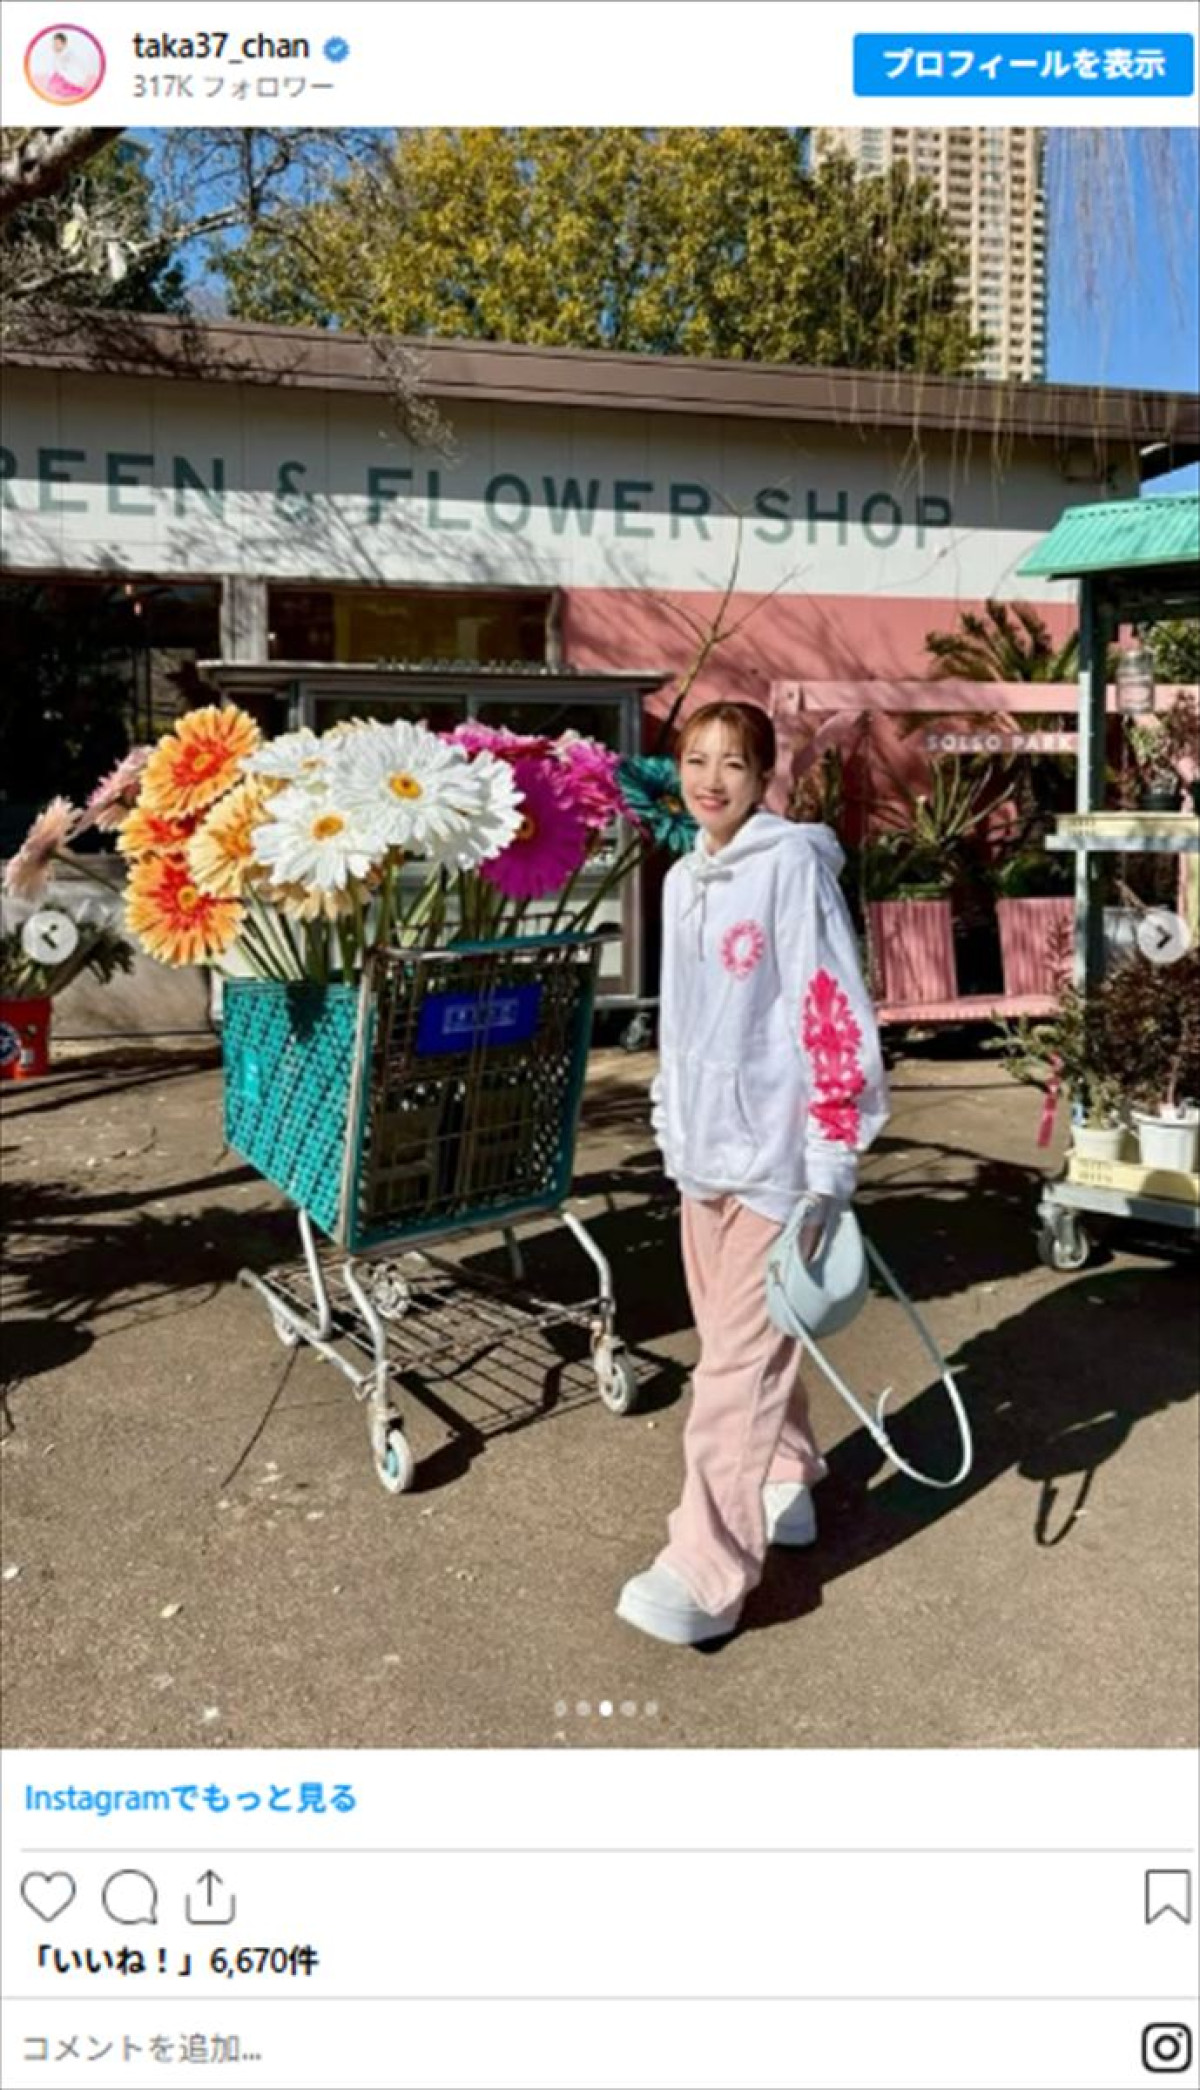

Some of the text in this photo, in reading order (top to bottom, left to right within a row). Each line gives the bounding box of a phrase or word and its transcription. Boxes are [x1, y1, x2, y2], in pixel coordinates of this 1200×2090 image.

[274, 461, 310, 524] &
[366, 467, 711, 540] FLOWER
[755, 487, 953, 549] SHOP
[1011, 734, 1073, 752] PARK
